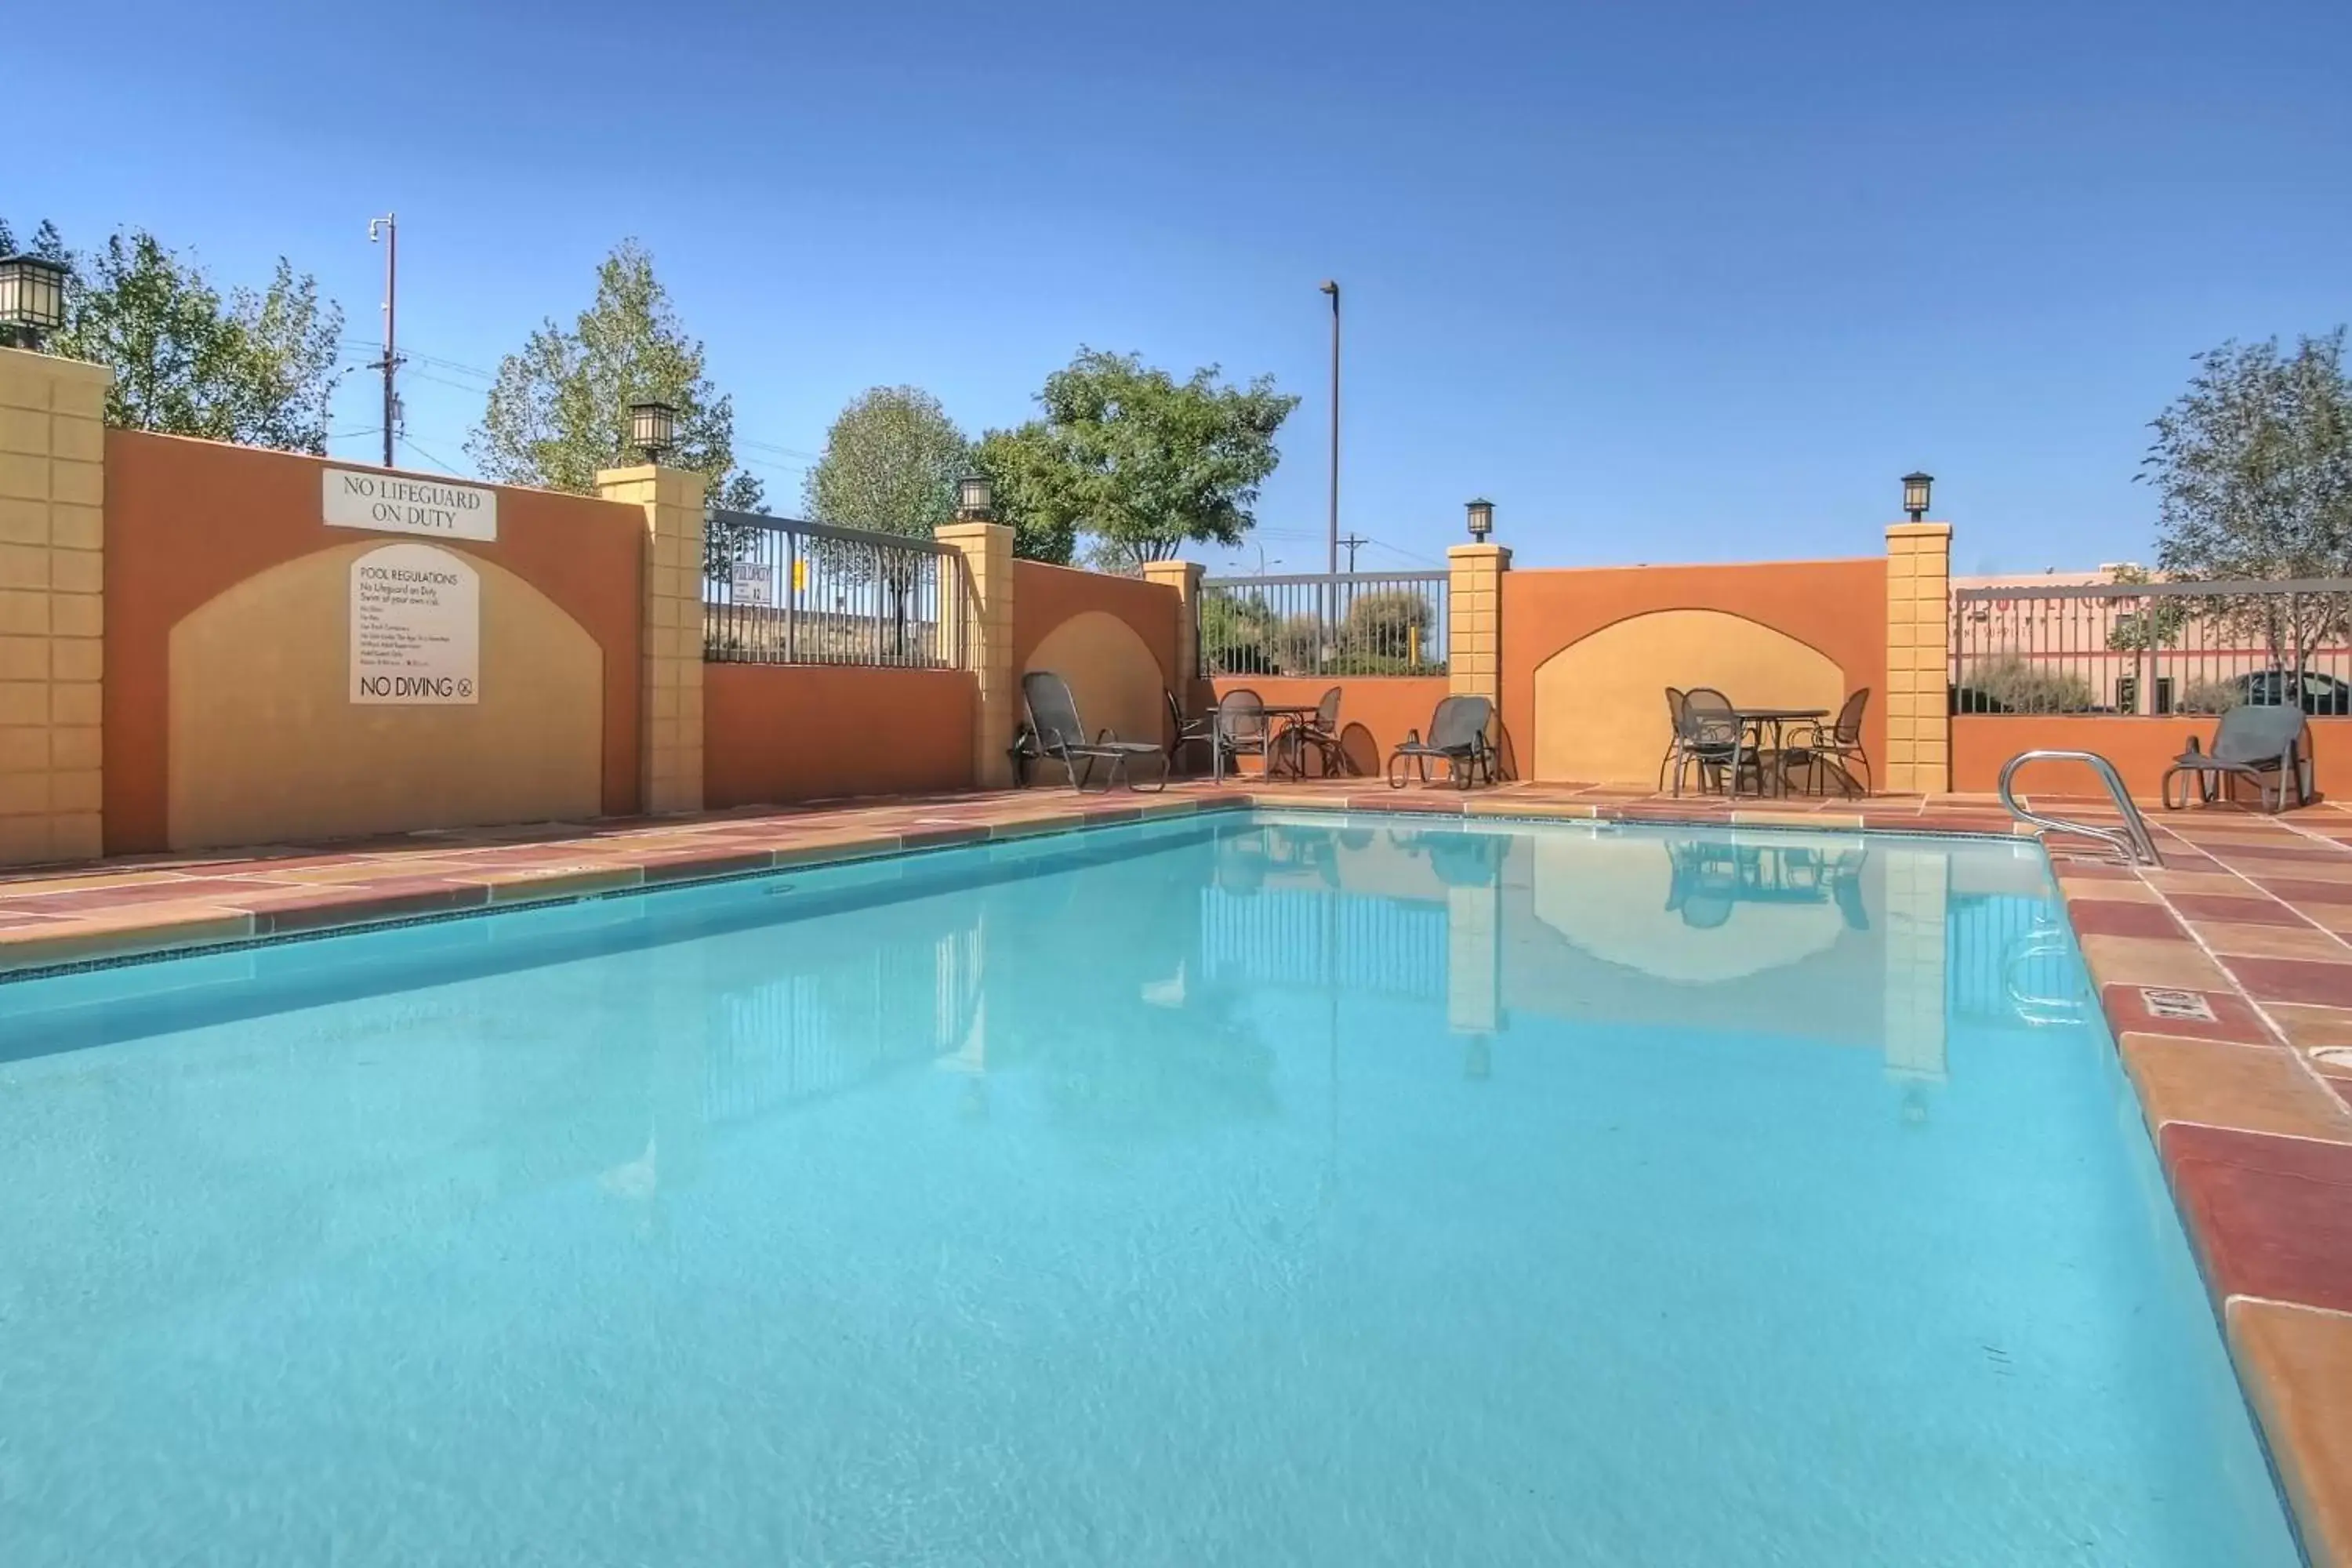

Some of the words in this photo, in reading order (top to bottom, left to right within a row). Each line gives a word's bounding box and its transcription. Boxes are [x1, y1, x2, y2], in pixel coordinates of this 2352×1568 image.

[343, 476, 374, 495] NO
[381, 481, 481, 510] LIFEGUARD
[372, 503, 401, 522] ON
[408, 506, 456, 528] DUTY
[361, 567, 388, 579] POOL
[391, 569, 458, 586] REGULATIONS
[361, 677, 391, 697] NO
[396, 677, 453, 697] DIVING
